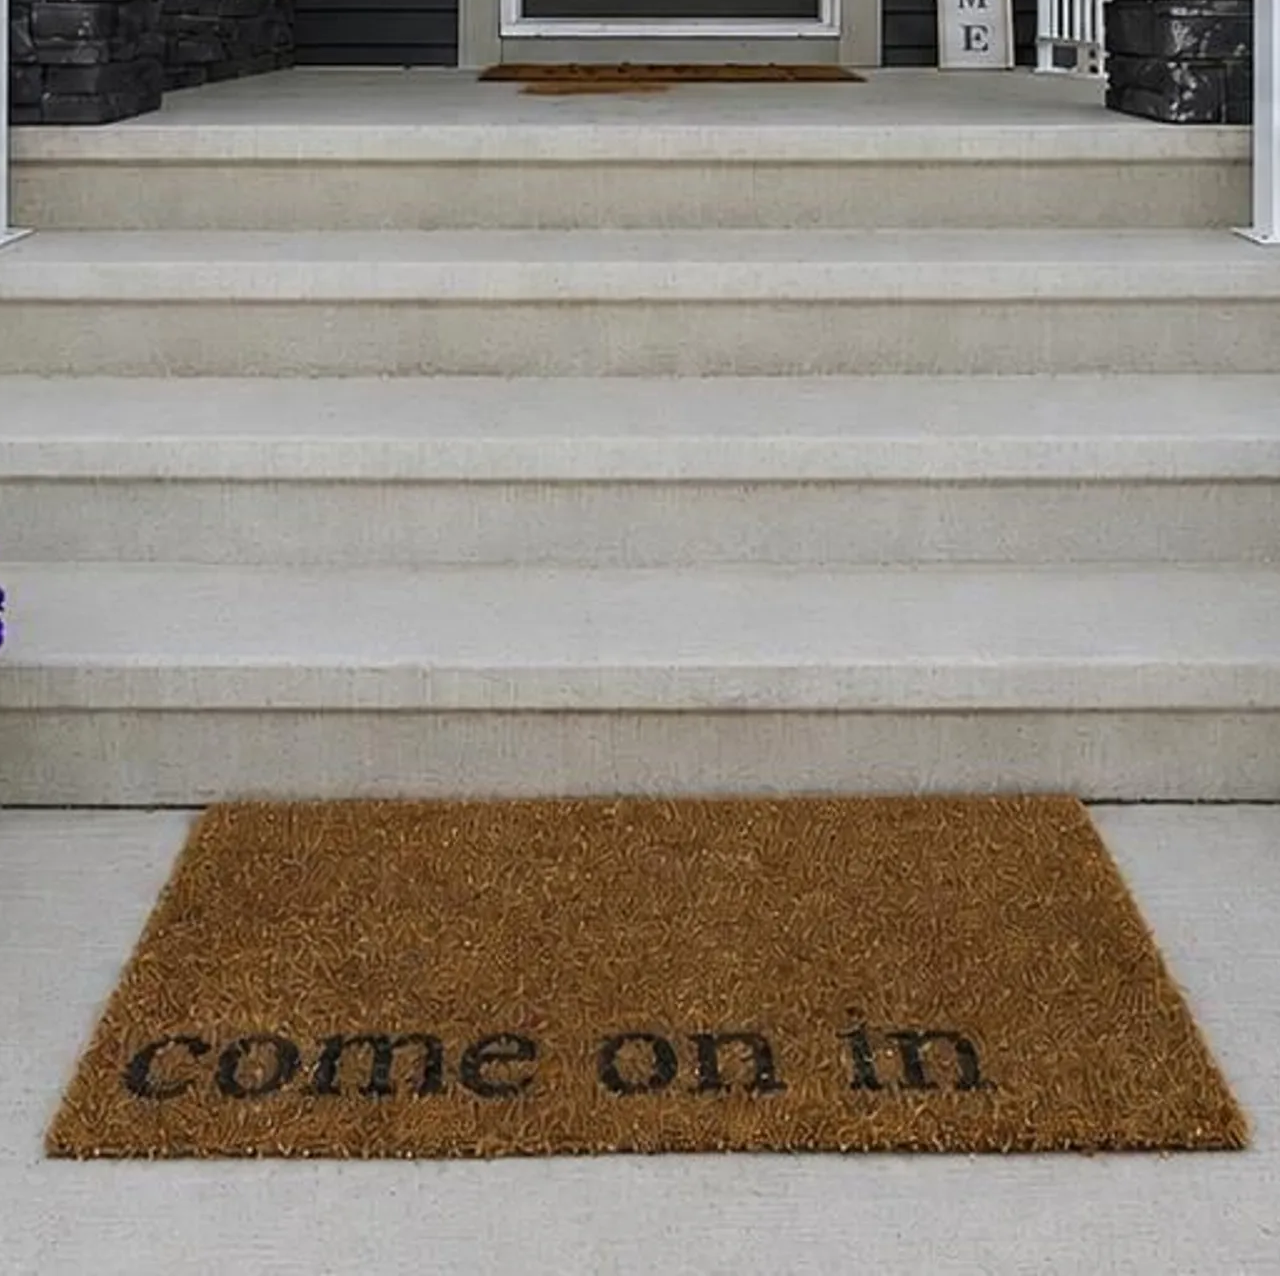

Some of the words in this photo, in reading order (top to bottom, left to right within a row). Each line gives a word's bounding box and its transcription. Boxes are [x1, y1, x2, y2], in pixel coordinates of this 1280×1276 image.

[122, 1033, 539, 1100] come
[599, 1032, 788, 1096] on
[836, 1007, 998, 1092] in
